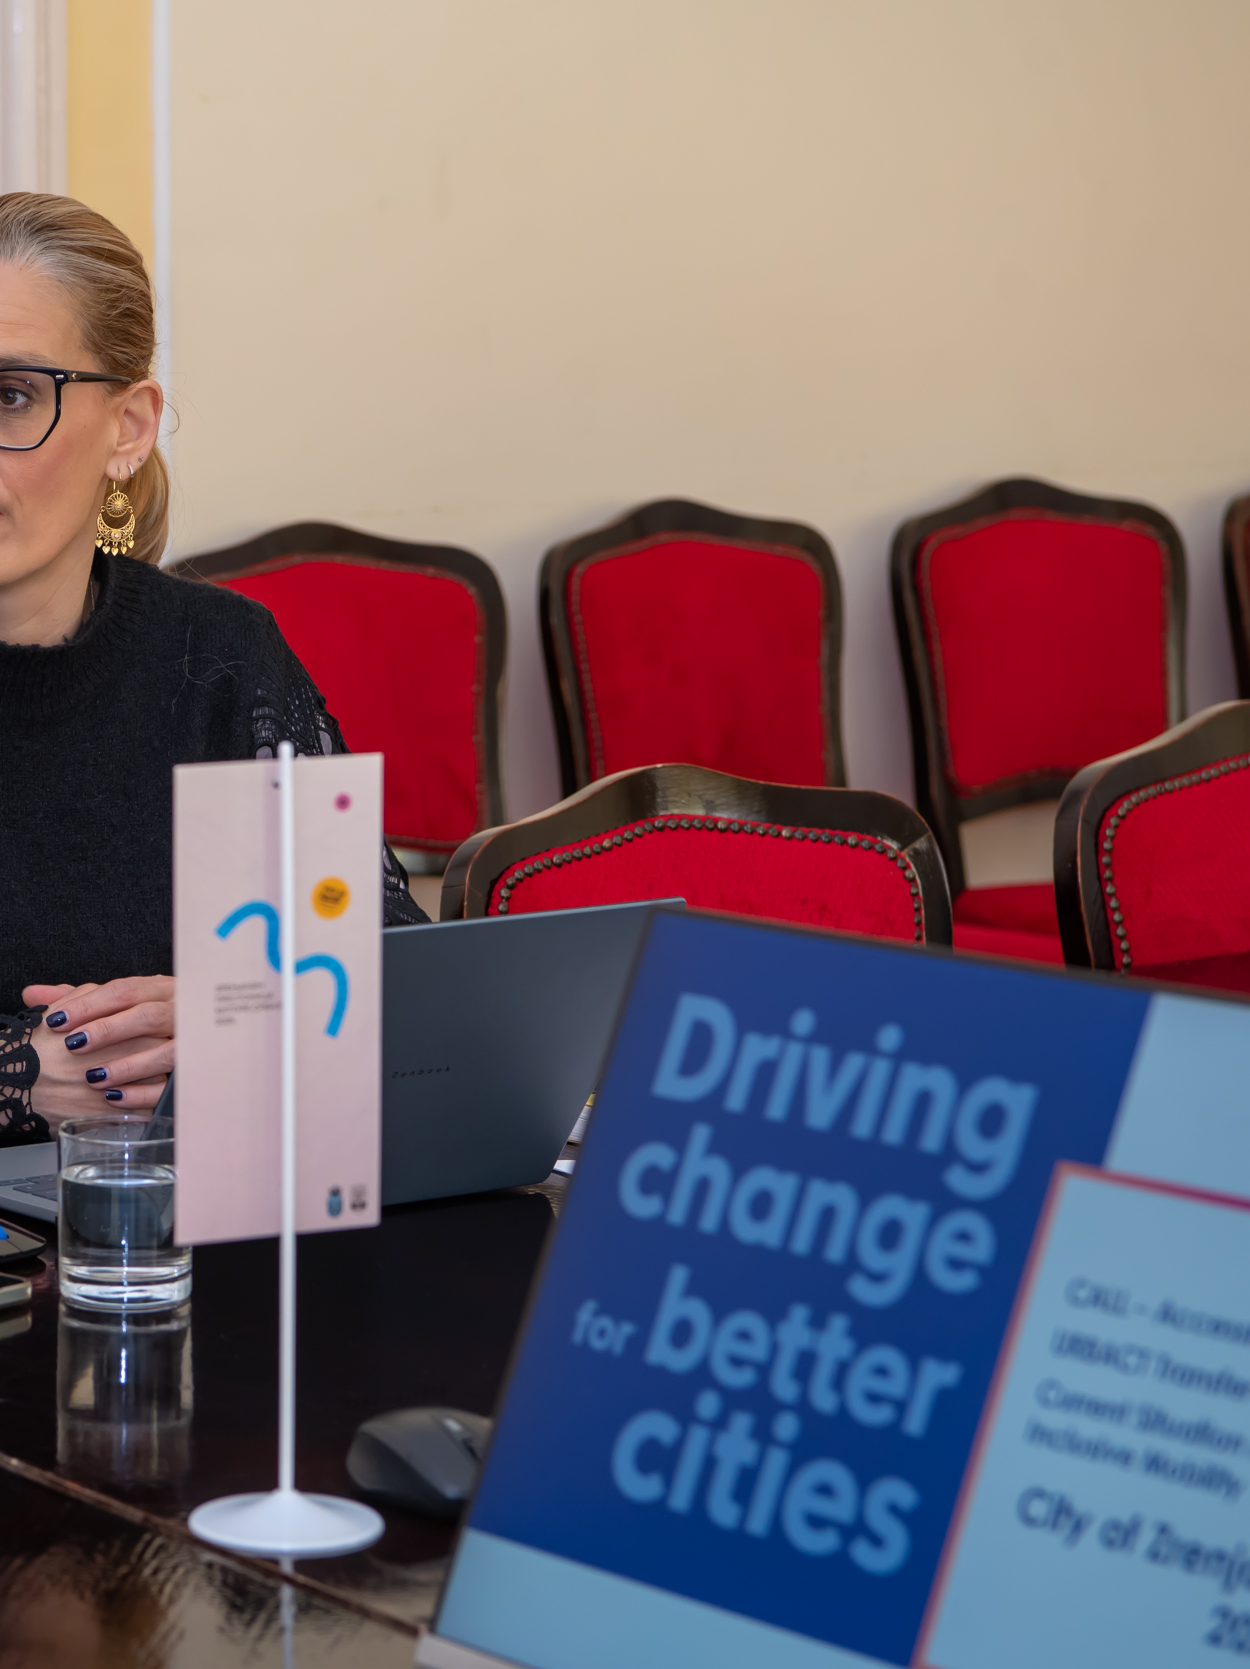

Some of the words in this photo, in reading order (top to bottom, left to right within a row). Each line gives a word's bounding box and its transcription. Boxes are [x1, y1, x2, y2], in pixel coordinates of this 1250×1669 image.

[651, 992, 1039, 1200] Driving
[618, 1122, 996, 1306] change
[1064, 1276, 1131, 1320] CALL
[571, 1298, 636, 1358] for
[644, 1264, 962, 1439] better
[1051, 1328, 1152, 1376] URBACT
[1035, 1376, 1130, 1427] Current
[1133, 1401, 1245, 1455] Situation
[610, 1390, 919, 1576] cities
[1024, 1416, 1135, 1472] Inclusive
[1140, 1446, 1246, 1505] Mobility
[1016, 1484, 1095, 1549] City
[1097, 1511, 1145, 1554] of
